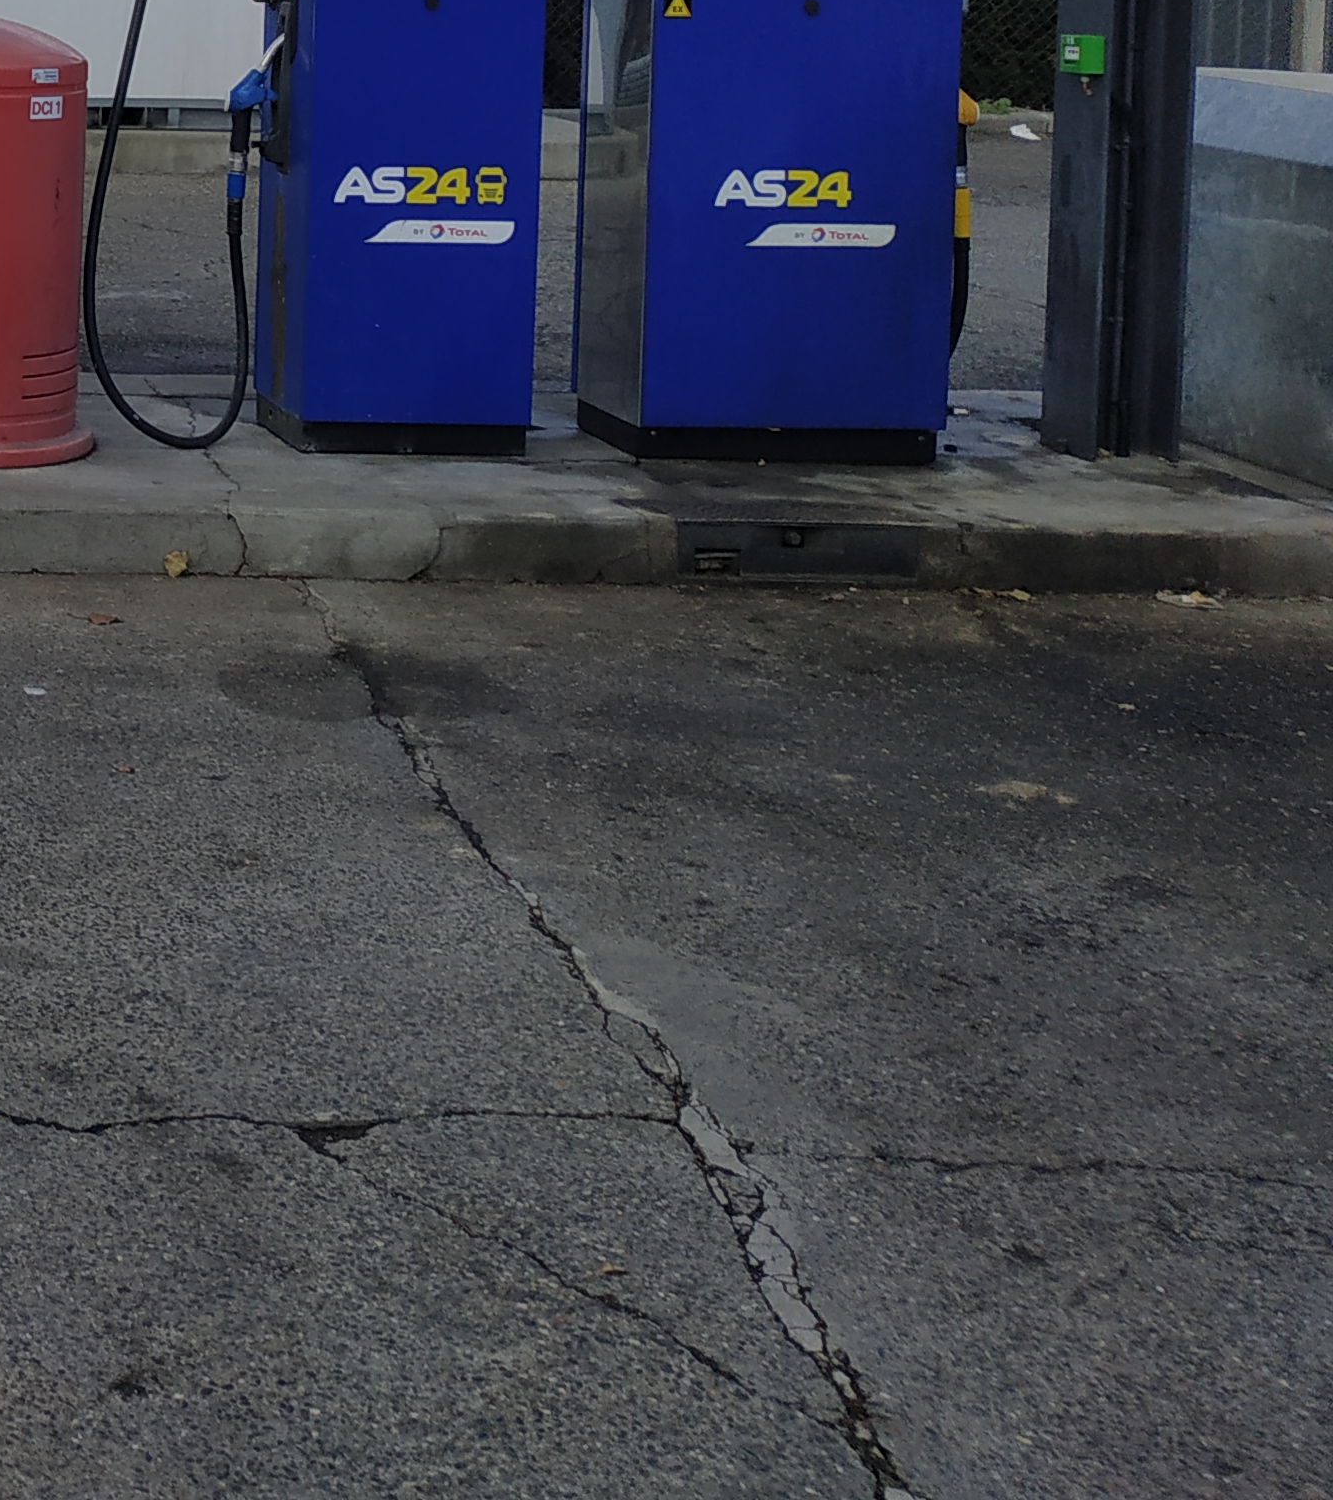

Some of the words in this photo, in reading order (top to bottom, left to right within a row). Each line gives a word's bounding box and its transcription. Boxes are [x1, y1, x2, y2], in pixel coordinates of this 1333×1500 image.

[333, 166, 471, 205] AS24
[714, 169, 853, 208] AS24
[447, 226, 488, 237] TOTAL
[828, 230, 870, 241] TOTAL
